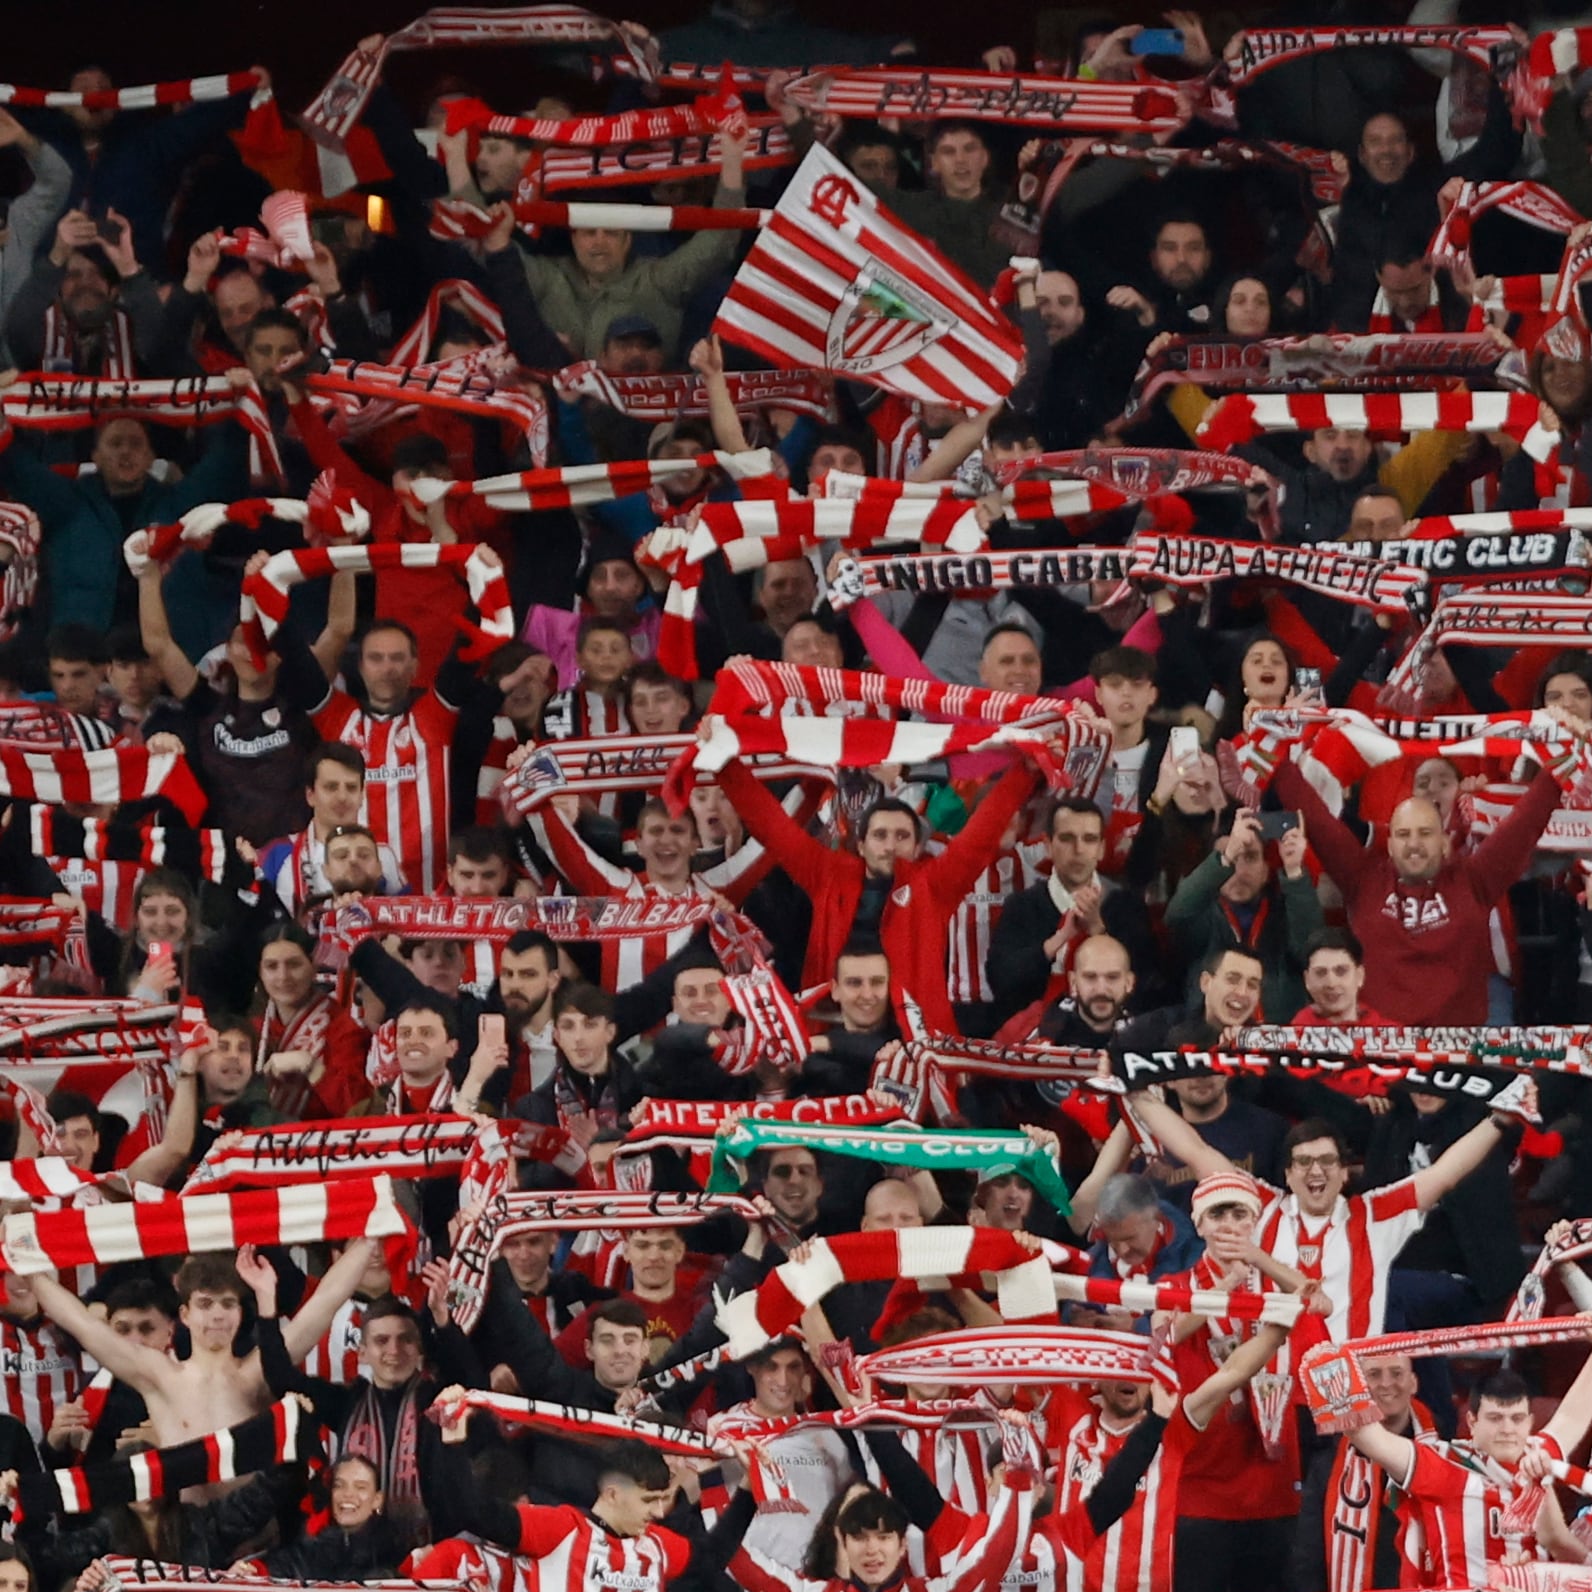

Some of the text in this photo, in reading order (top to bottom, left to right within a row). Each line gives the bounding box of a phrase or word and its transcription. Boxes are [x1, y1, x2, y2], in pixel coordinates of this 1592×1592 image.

[1466, 533, 1553, 564] CLUB
[1009, 554, 1125, 585] CABA
[1147, 534, 1399, 603] AUPA ATHLETIC
[213, 722, 290, 757] Kutxabank
[376, 901, 715, 928] ATHLETIC BILBAO
[1366, 1055, 1497, 1098] CLUB
[253, 1117, 478, 1178] Athletic Club
[921, 1138, 1037, 1157] CLUB
[590, 1556, 656, 1589] Kutxabank
